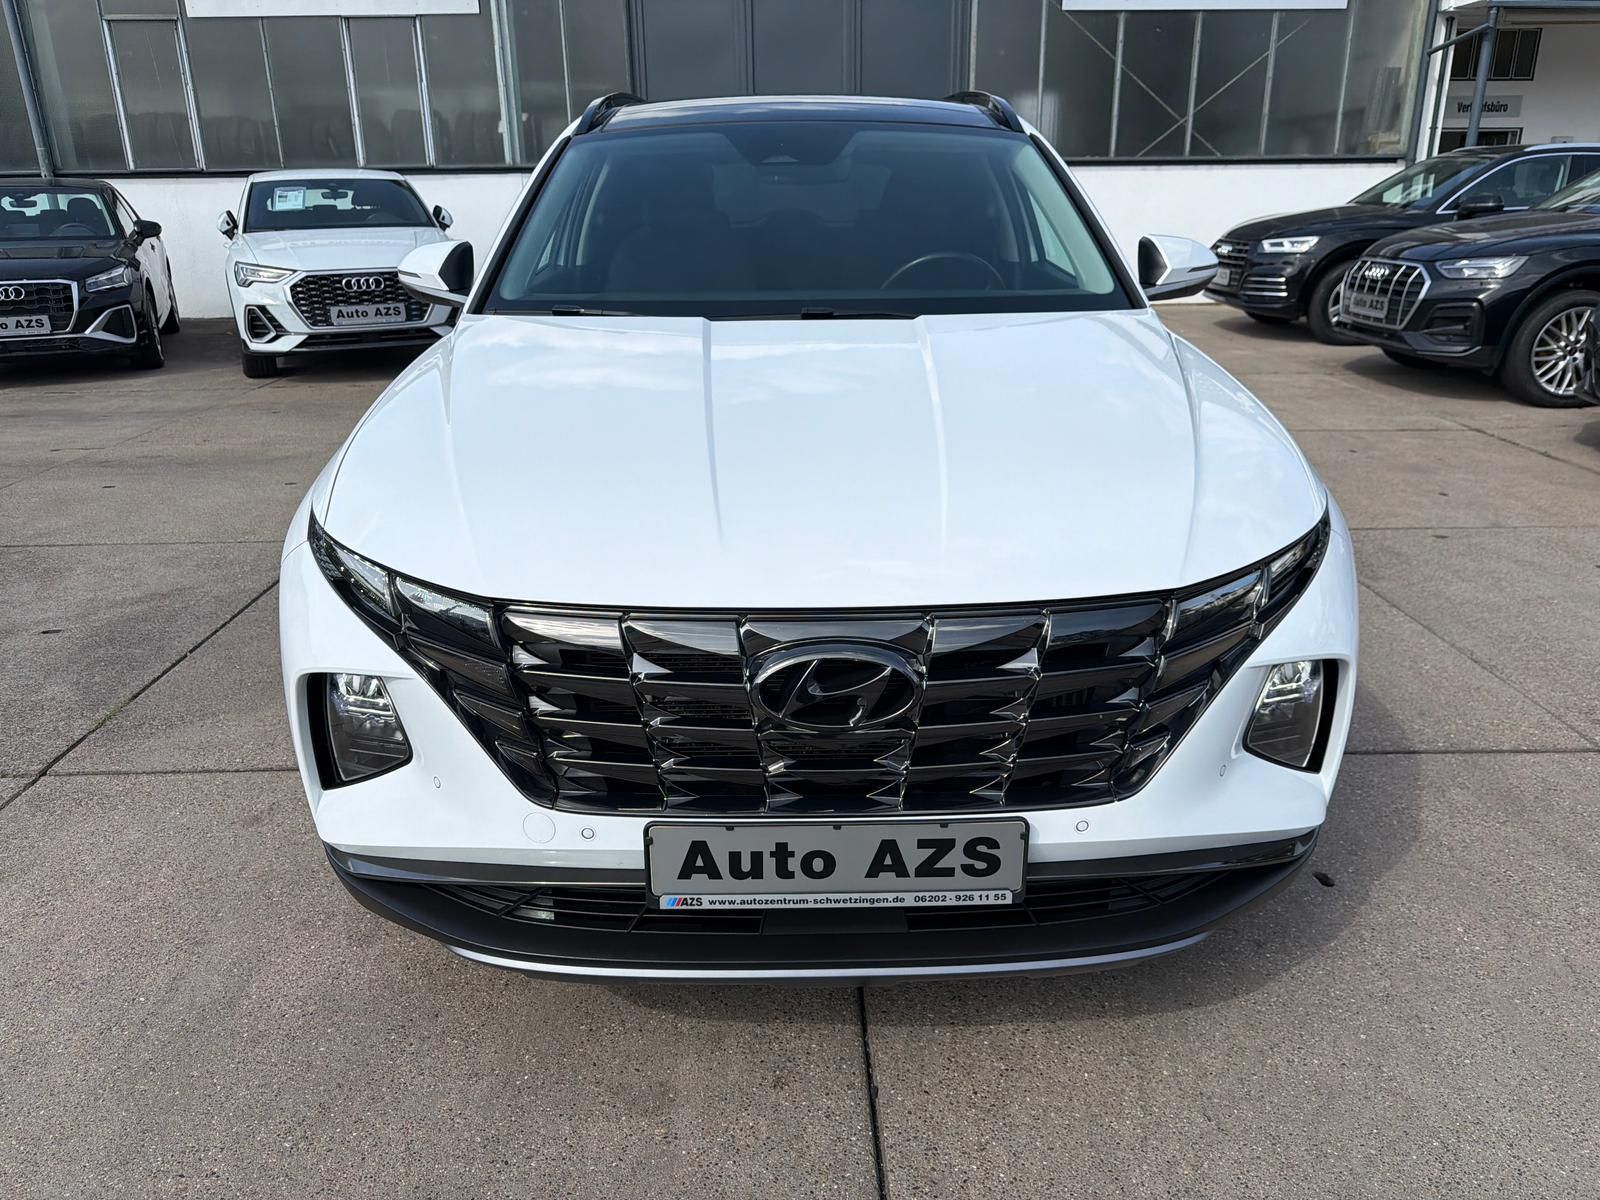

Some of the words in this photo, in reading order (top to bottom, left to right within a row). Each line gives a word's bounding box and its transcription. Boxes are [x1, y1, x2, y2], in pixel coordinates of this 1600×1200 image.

[1457, 101, 1508, 112] Verfsbüro
[337, 309, 368, 318] Auto
[375, 306, 402, 317] AZS
[15, 318, 45, 329] AZS
[677, 840, 836, 880] Auto
[864, 836, 1001, 878] AZS
[681, 897, 703, 906] AZS
[708, 896, 905, 906] www.autozentrum-schwetzingen.de
[914, 895, 947, 903] 06202
[955, 894, 974, 902] 926
[978, 894, 990, 902] 11
[994, 893, 1007, 901] 55
